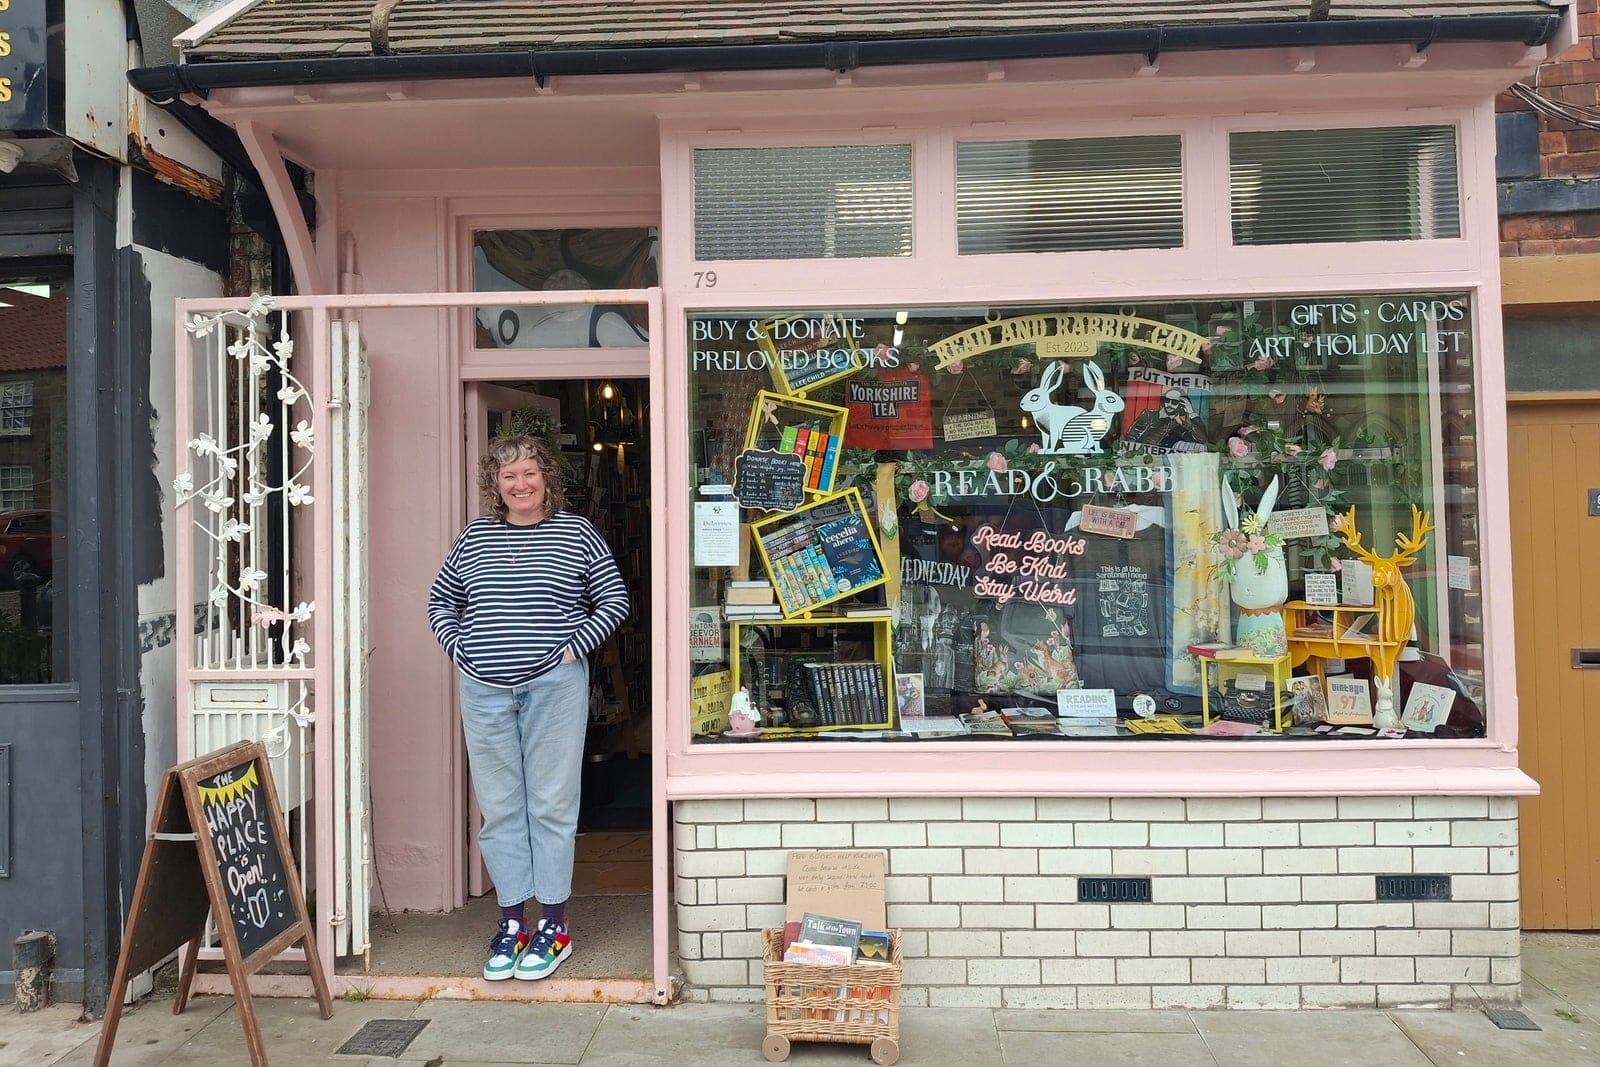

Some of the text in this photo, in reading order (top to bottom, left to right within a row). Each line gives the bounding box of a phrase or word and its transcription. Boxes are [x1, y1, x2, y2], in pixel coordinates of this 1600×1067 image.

[693, 271, 718, 289] 79
[1291, 300, 1464, 326] GIFTS CARDS
[692, 317, 865, 341] BUY & DONATE
[936, 328, 992, 364] READ
[1001, 318, 1047, 343] AND
[1046, 341, 1089, 353] Est 2025
[1248, 331, 1465, 358] ART HOLIDAY LET
[692, 349, 809, 371] PRELOVED
[816, 347, 900, 370] BOOKS
[806, 372, 826, 384] CHILD
[1134, 370, 1161, 384] PUT
[1163, 375, 1190, 387] THE
[850, 383, 918, 402] YORKSHIRE
[873, 402, 897, 417] TEA
[949, 412, 987, 423] WARNING
[933, 468, 1031, 497] READ
[1031, 461, 1083, 502] &
[825, 525, 858, 544] cecelia
[832, 535, 855, 549] ahern
[972, 526, 1086, 555] Read Books
[985, 552, 1068, 581] Be Kind
[1100, 565, 1114, 573] This
[1115, 565, 1121, 573] is
[1129, 565, 1141, 573] the
[974, 575, 1077, 605] Stay Weird
[1065, 694, 1108, 704] READING
[213, 771, 234, 789] THE
[205, 789, 258, 838] HAPPY
[217, 820, 269, 862] PLACE
[227, 854, 268, 902] Open!
[807, 919, 825, 931] Talk
[838, 924, 857, 936] Town
